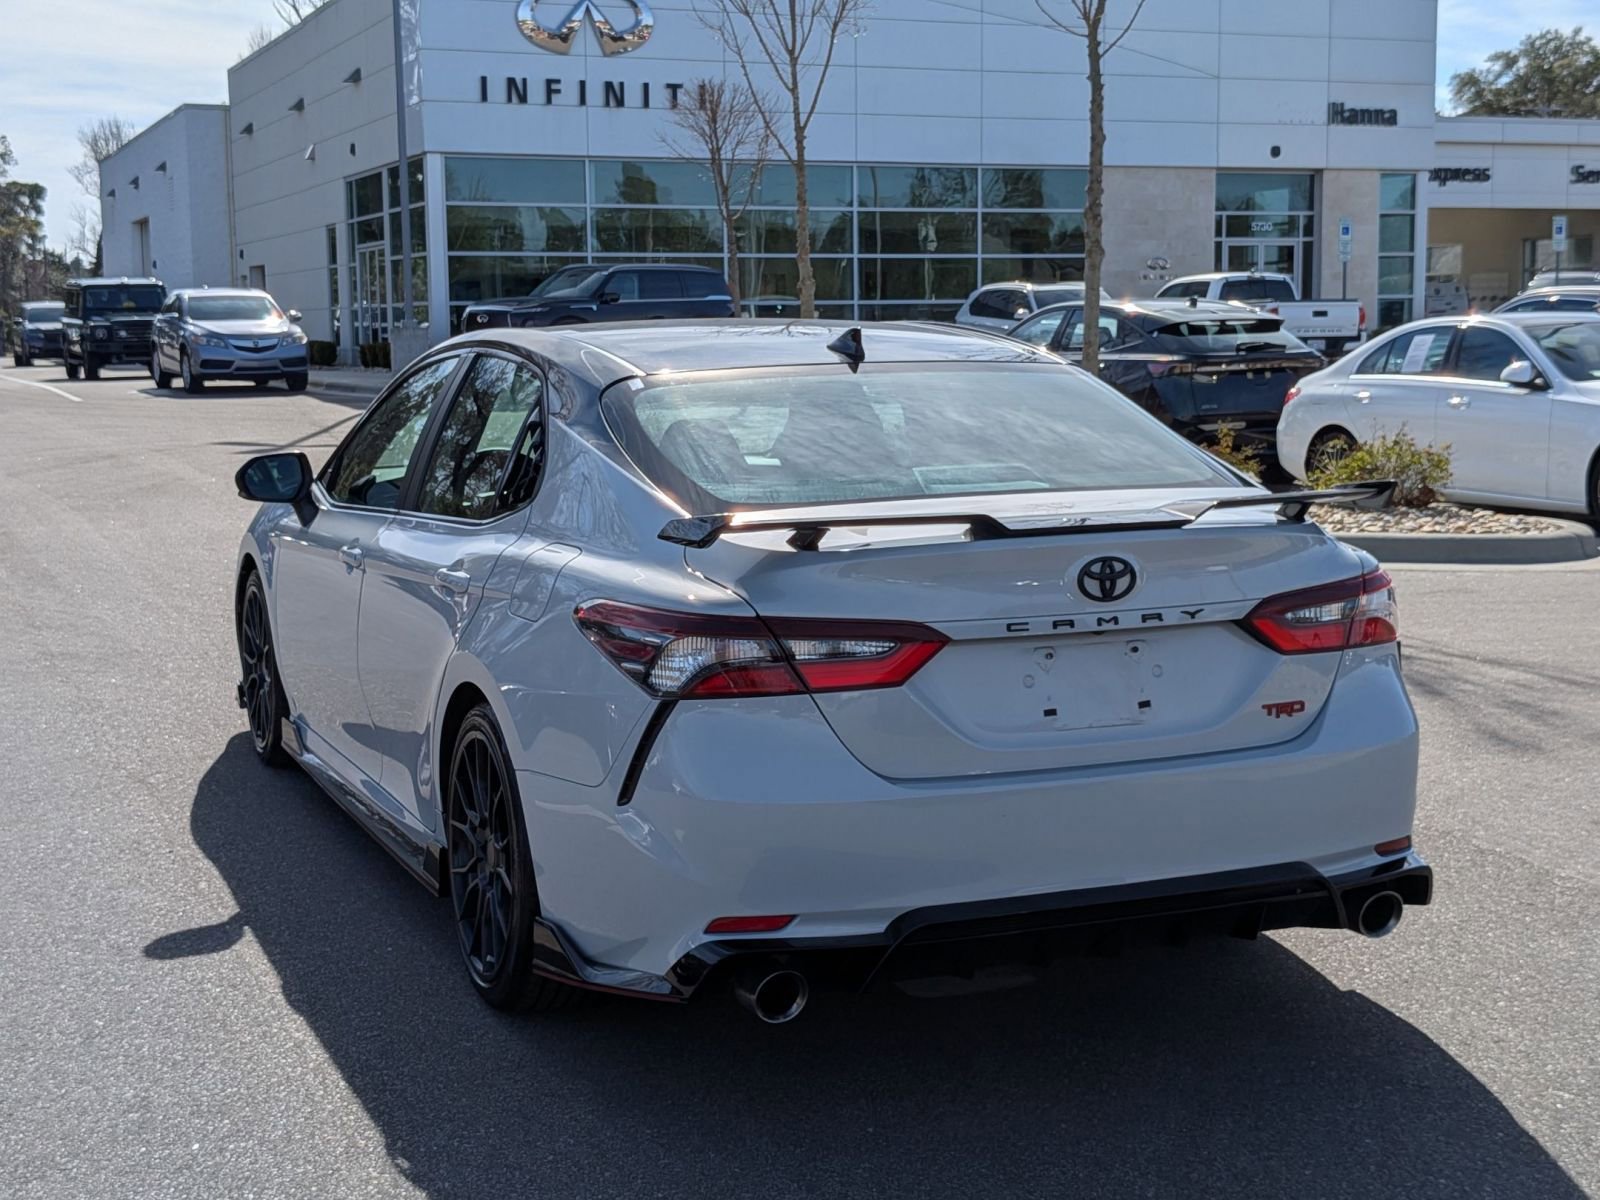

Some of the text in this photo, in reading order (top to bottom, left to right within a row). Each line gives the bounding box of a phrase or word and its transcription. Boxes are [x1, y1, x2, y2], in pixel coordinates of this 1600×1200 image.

[1328, 102, 1398, 126] Hanna
[1006, 608, 1204, 632] CAMRY
[1261, 699, 1305, 719] TRD
